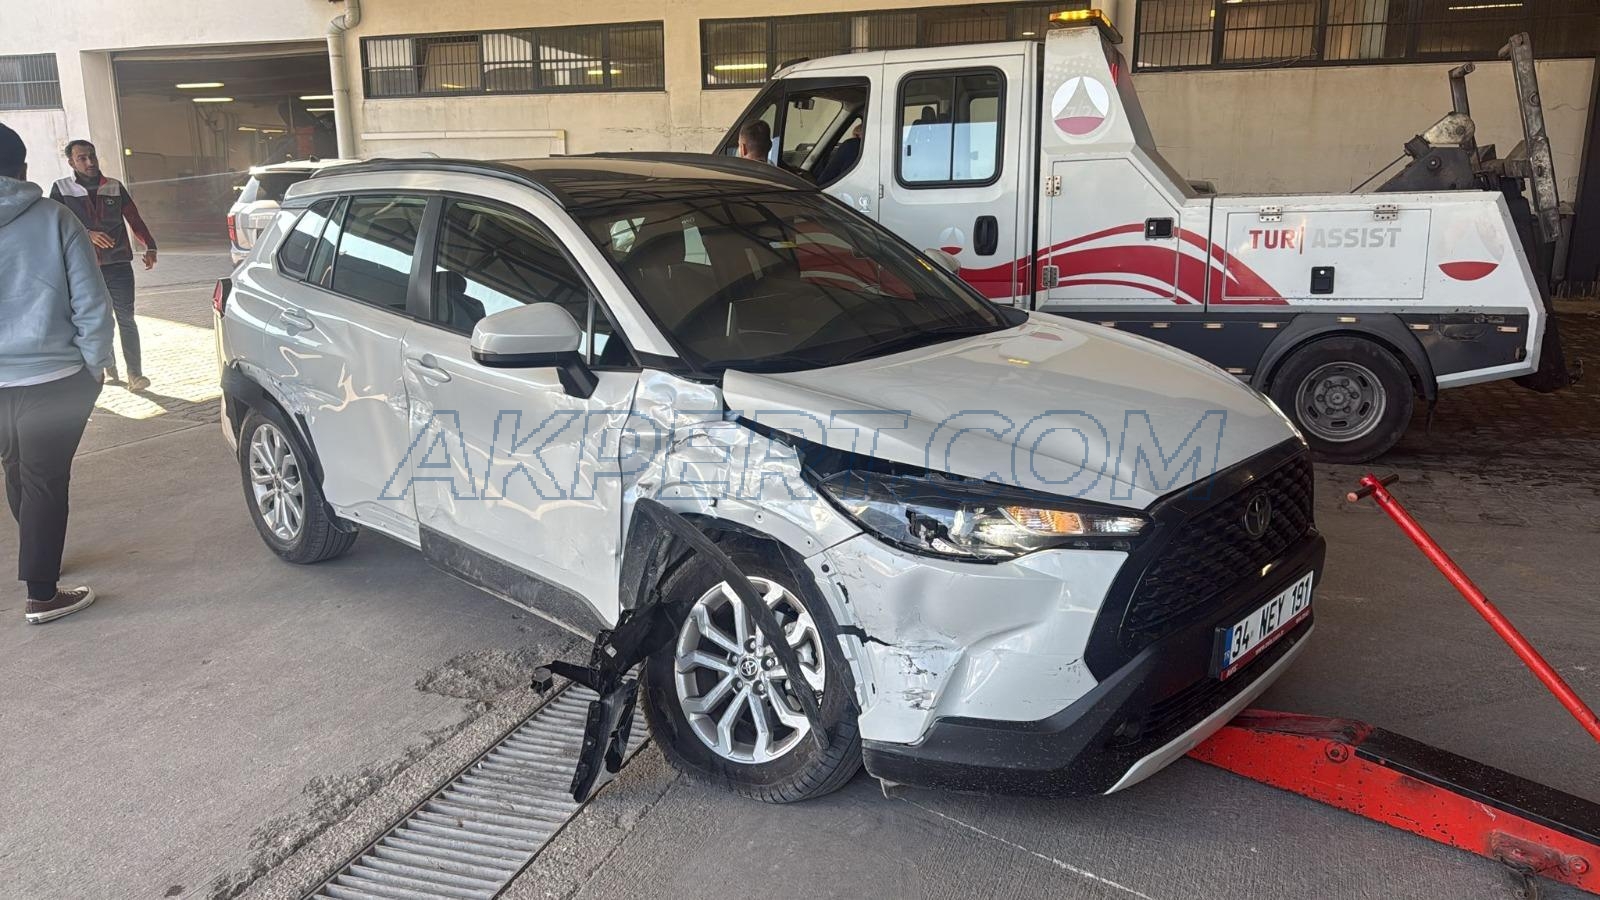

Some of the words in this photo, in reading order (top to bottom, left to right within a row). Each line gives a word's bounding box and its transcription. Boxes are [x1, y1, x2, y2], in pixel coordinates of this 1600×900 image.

[1249, 229, 1295, 249] TUR
[1311, 228, 1402, 248] ASSIST
[1232, 620, 1250, 658] 34
[1258, 595, 1285, 640] NEY
[1291, 577, 1310, 615] 191
